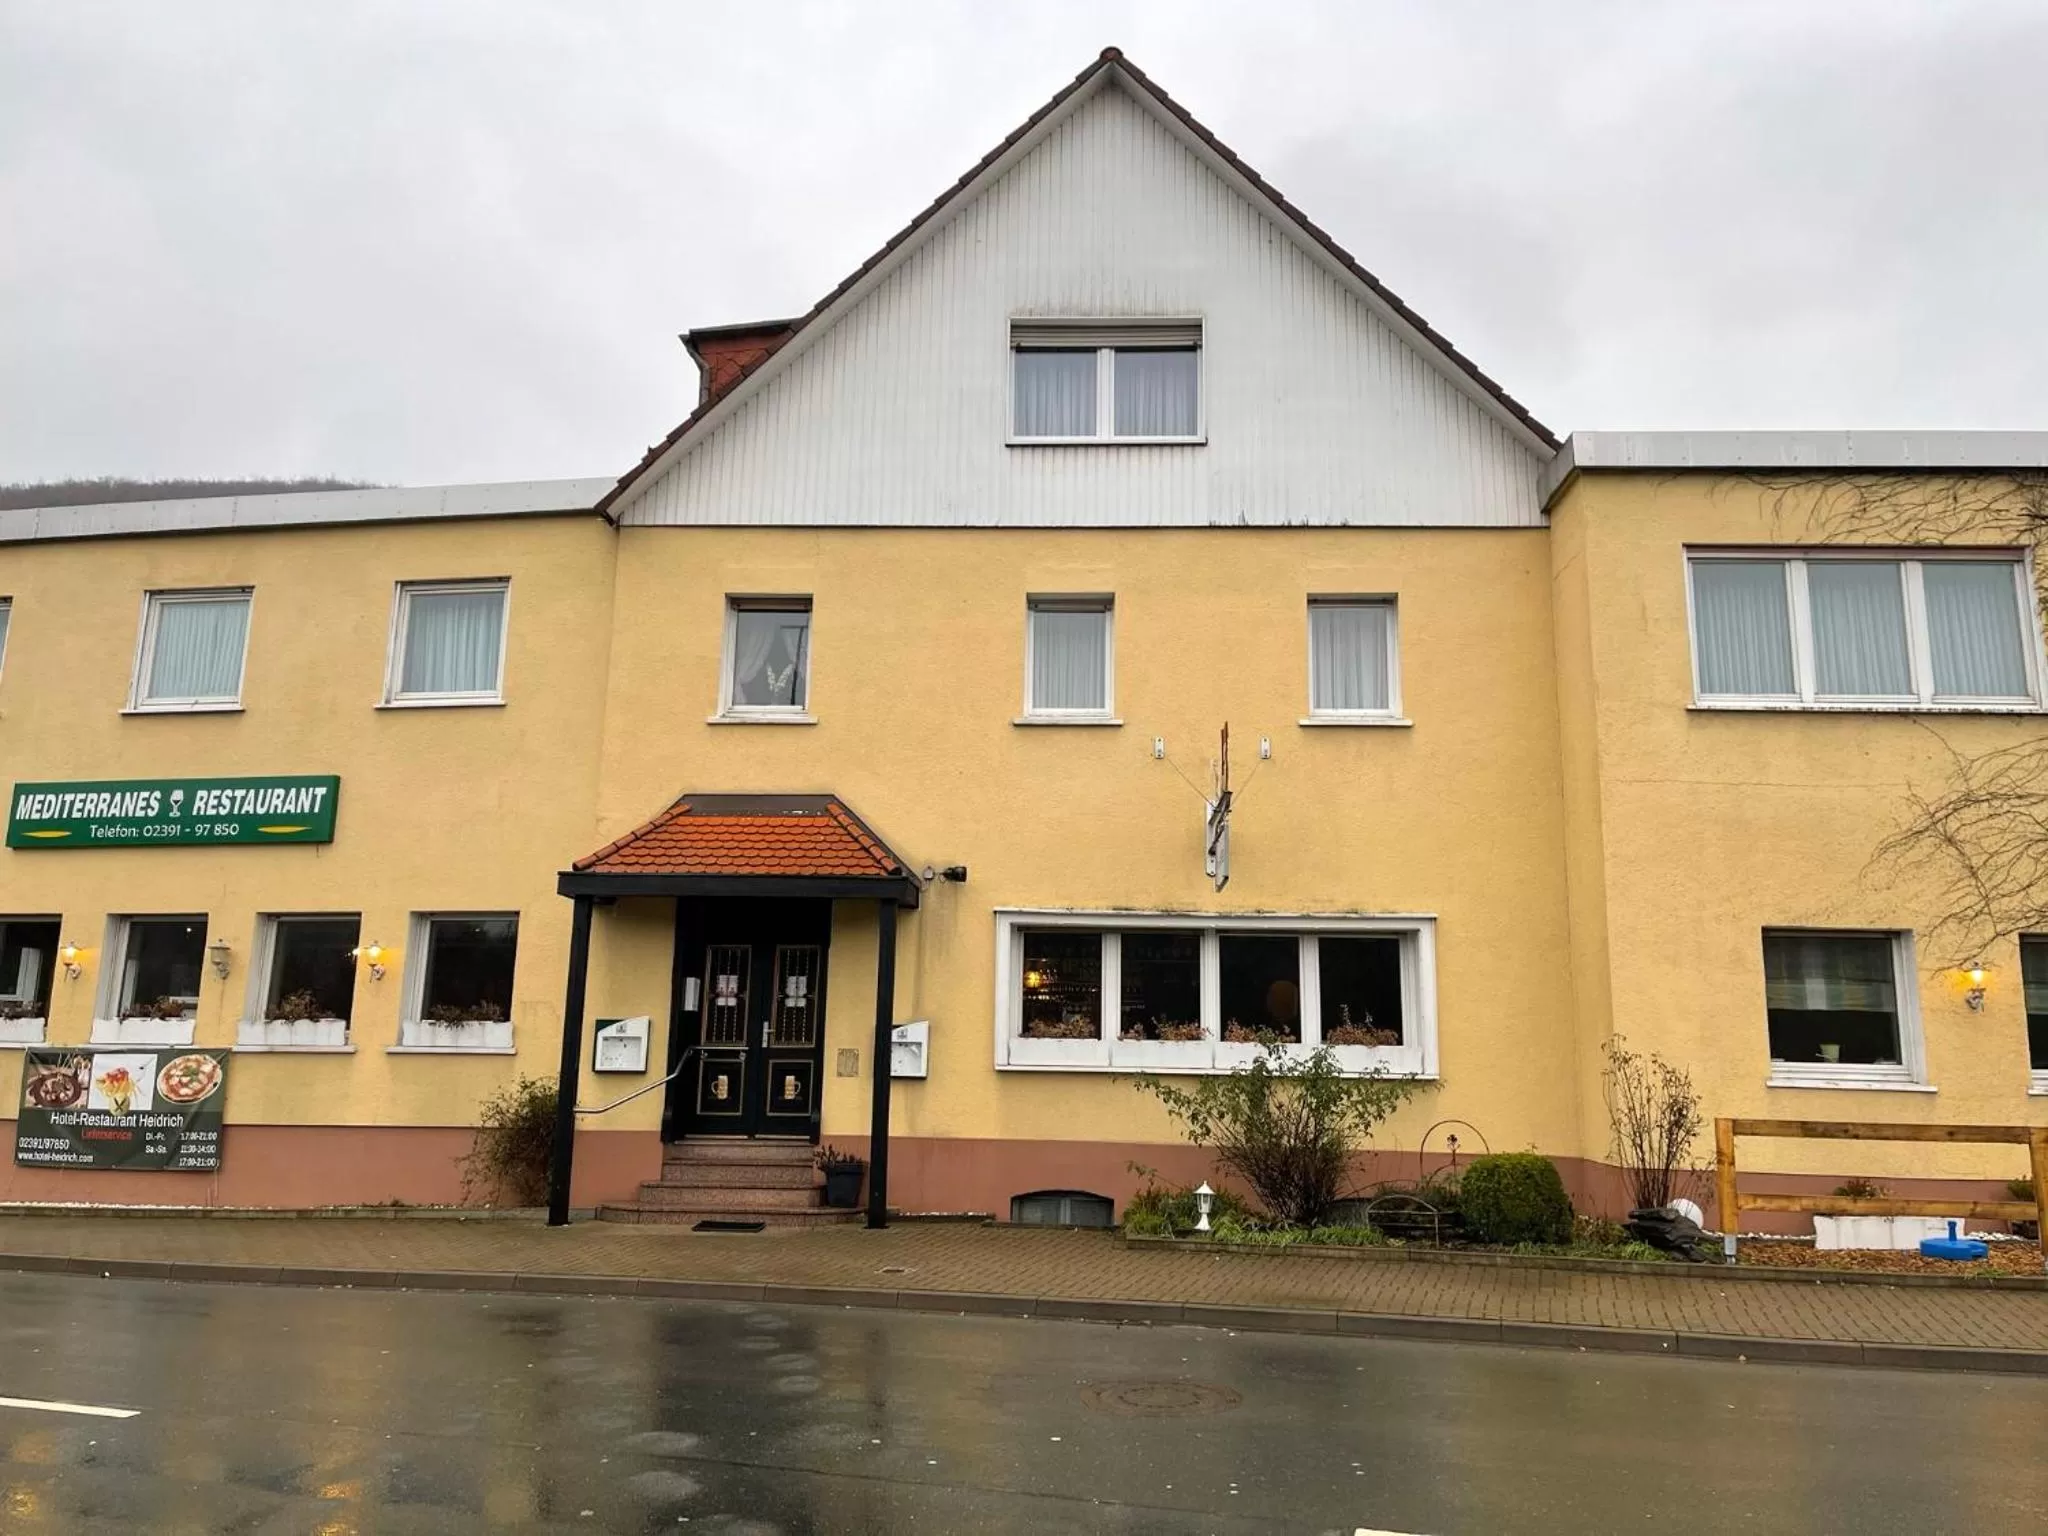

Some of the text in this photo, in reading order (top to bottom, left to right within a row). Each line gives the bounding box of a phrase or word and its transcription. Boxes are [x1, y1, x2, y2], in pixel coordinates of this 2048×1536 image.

[15, 787, 328, 820] MEDITERRANES RESTAURANT
[89, 824, 140, 838] Telefon:
[143, 824, 181, 837] 02391
[194, 825, 209, 837] 97
[213, 824, 240, 836] 850
[50, 1112, 184, 1128] Hotel-Restaurant Heidrich
